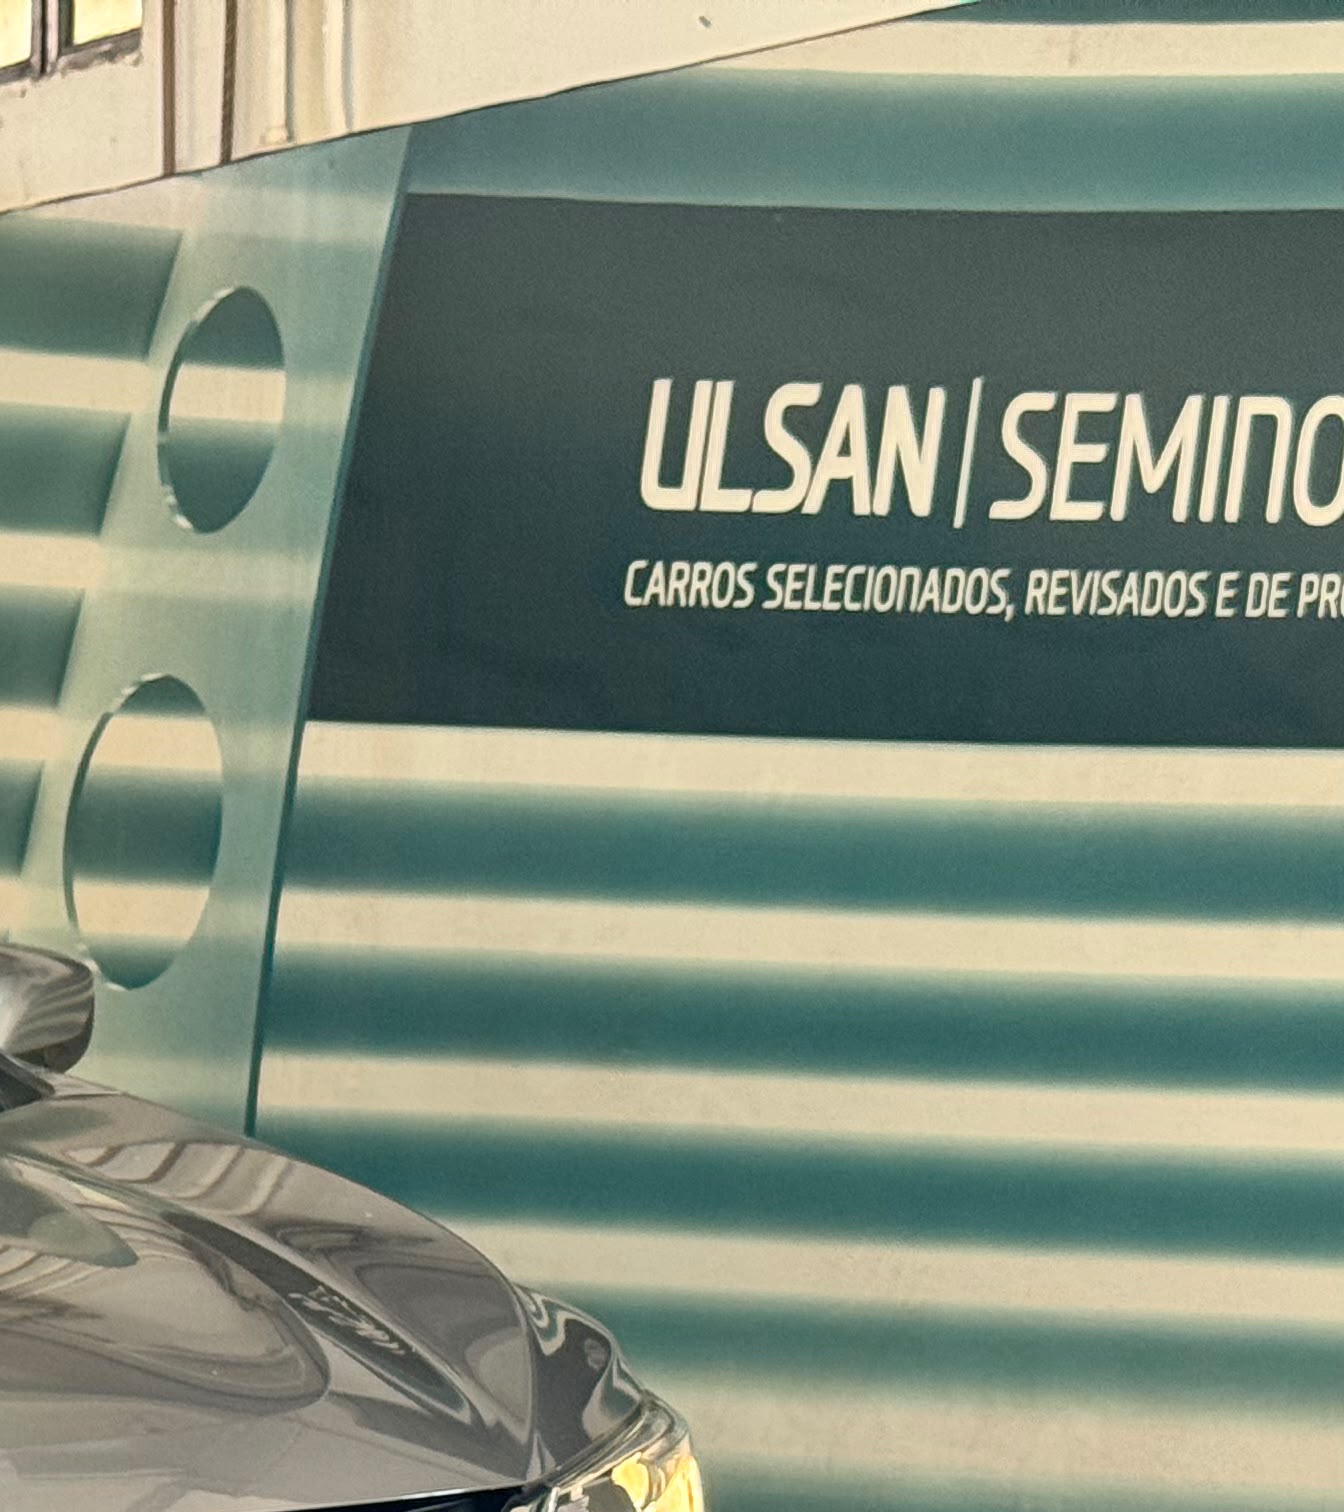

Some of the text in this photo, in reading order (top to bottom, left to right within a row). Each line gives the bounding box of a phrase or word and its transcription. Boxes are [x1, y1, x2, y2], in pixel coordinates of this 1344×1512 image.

[640, 378, 1344, 527] ULSAN SEMINO
[623, 559, 1344, 622] CARROS SELECIONADOS, REVISADOS E DE PR
